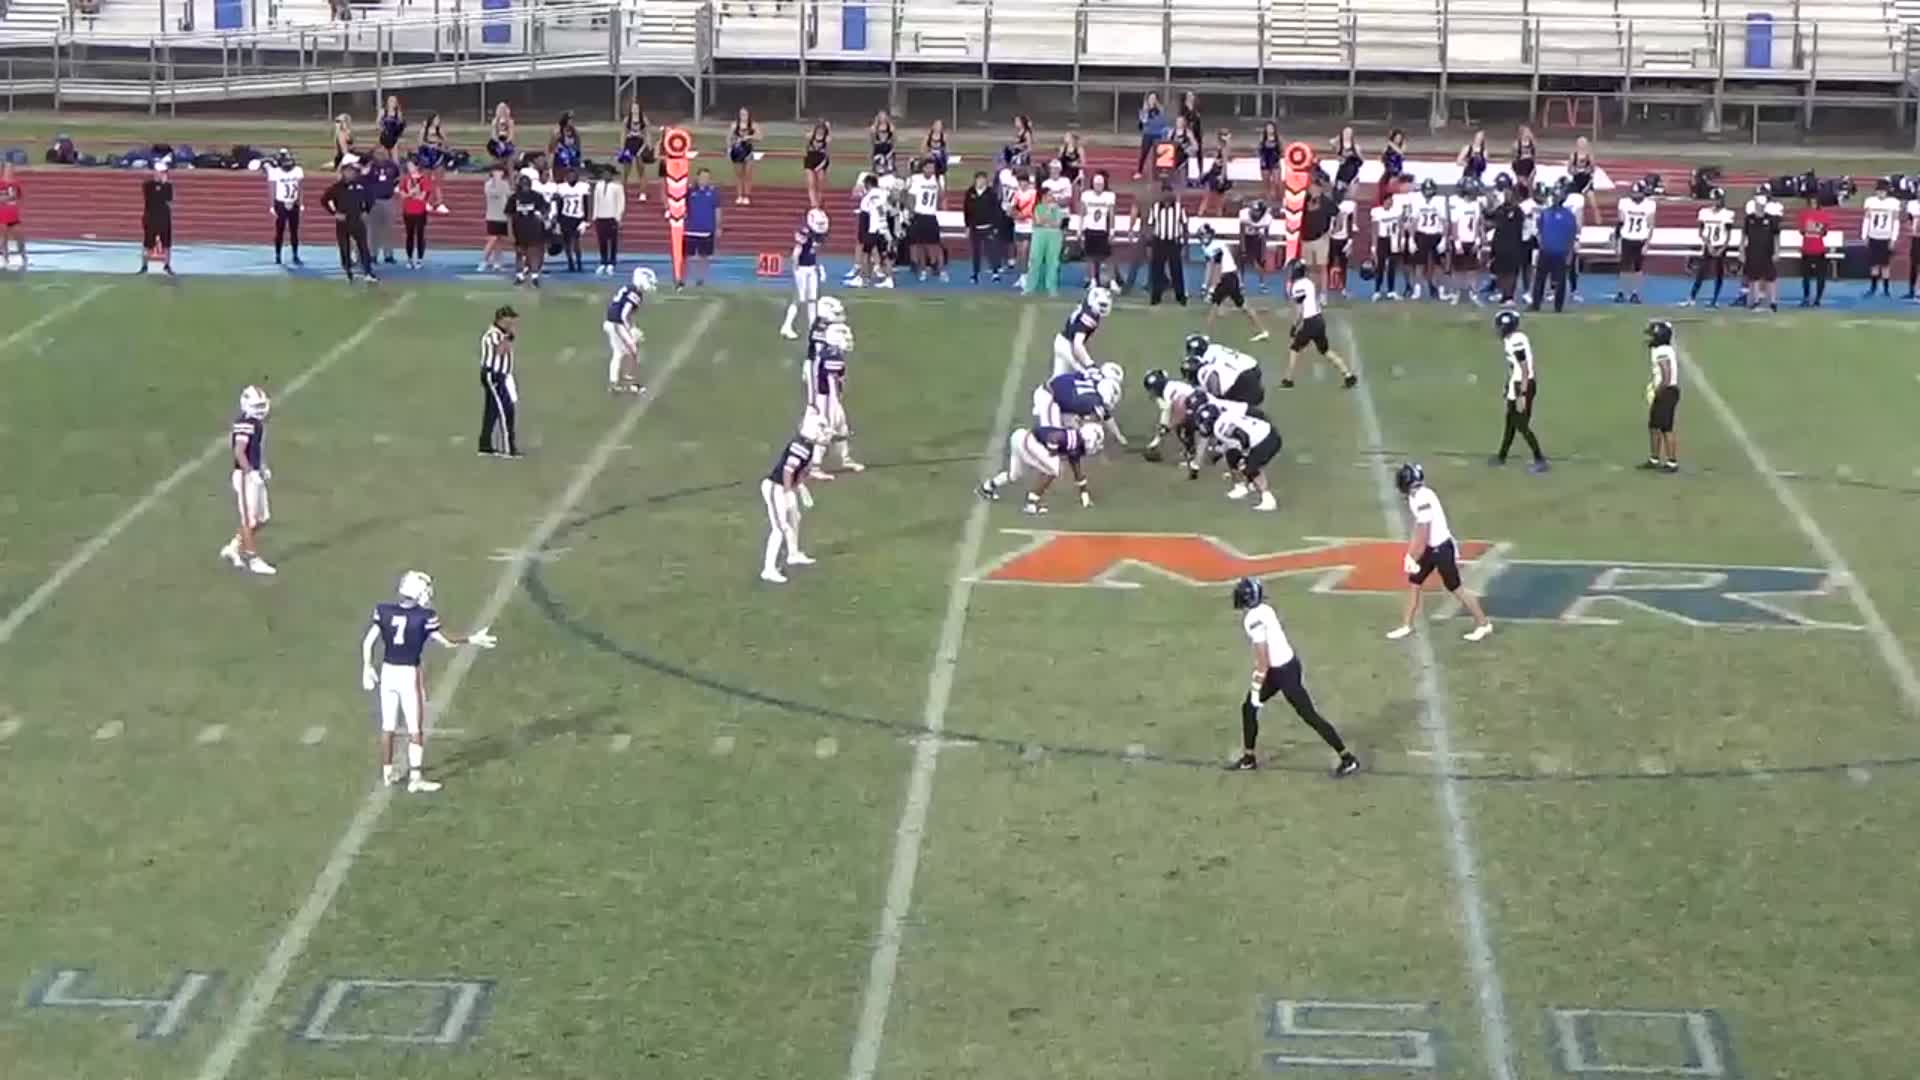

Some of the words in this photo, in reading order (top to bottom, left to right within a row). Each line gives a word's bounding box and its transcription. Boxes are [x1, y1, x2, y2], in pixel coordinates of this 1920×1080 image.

[1156, 144, 1175, 168] 2
[759, 255, 780, 273] 40
[391, 615, 407, 645] 7
